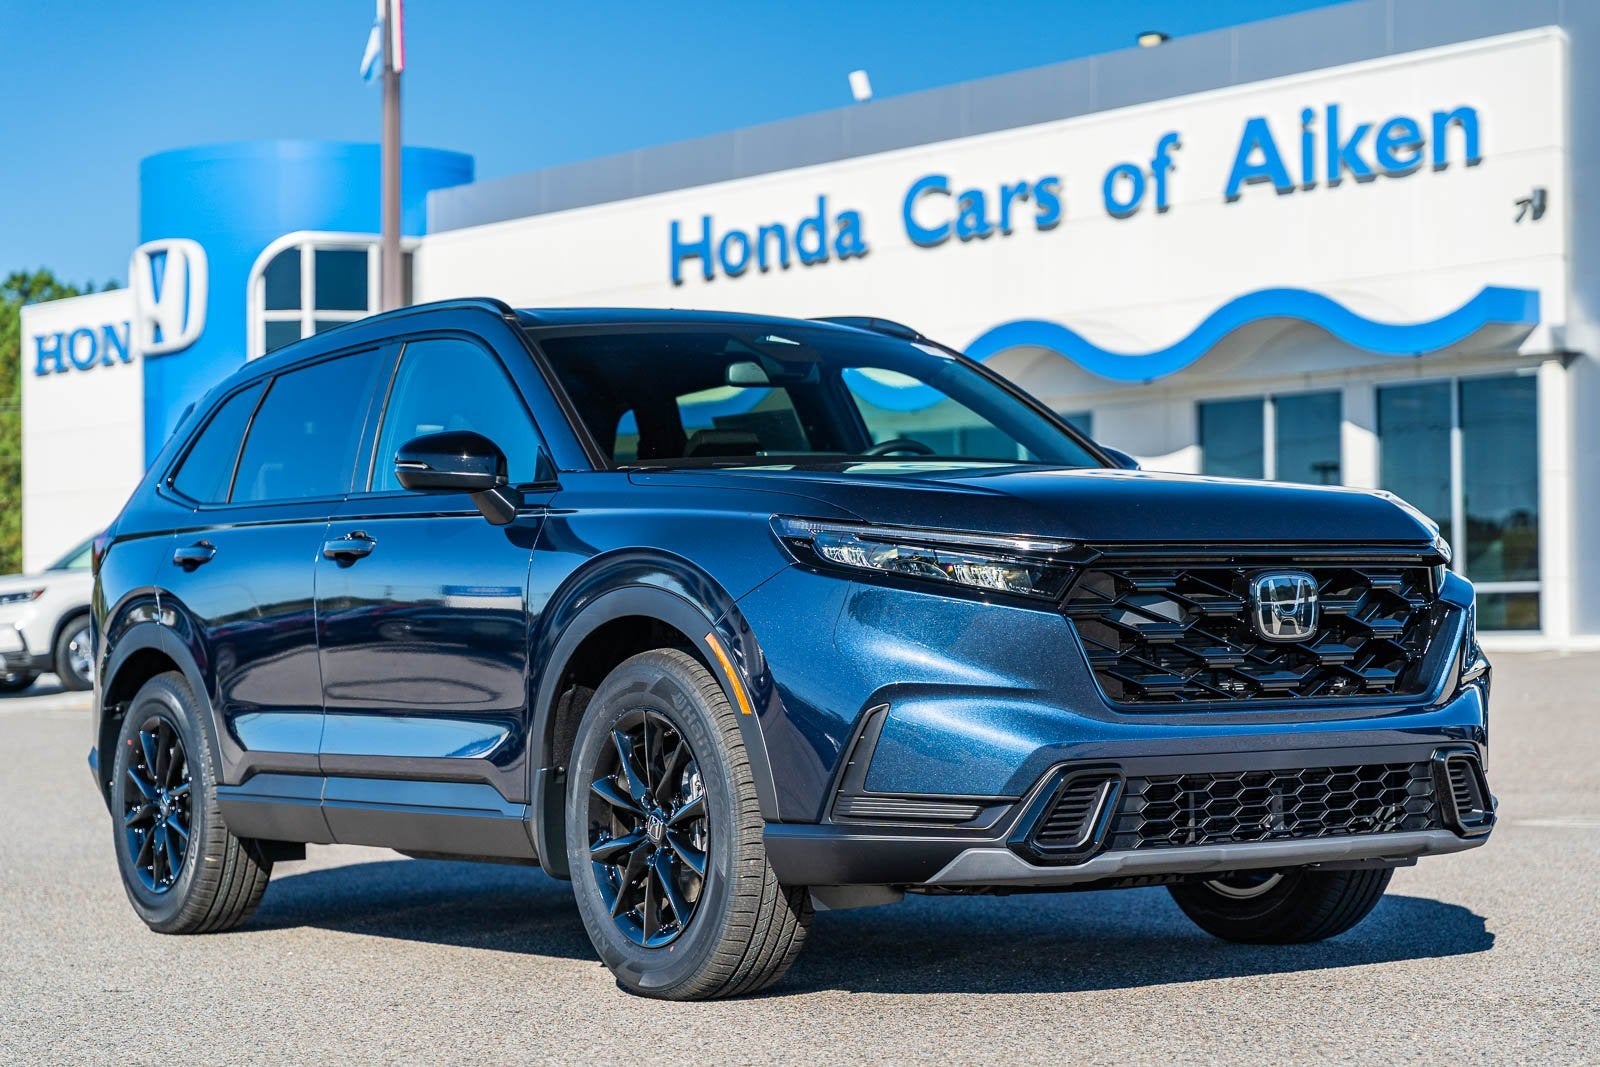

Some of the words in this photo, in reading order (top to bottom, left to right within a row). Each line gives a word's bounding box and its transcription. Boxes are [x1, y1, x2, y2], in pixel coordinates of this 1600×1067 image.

[669, 194, 868, 285] Honda
[902, 173, 1063, 246] Cars
[1102, 131, 1181, 217] of
[1223, 103, 1481, 201] Aiken
